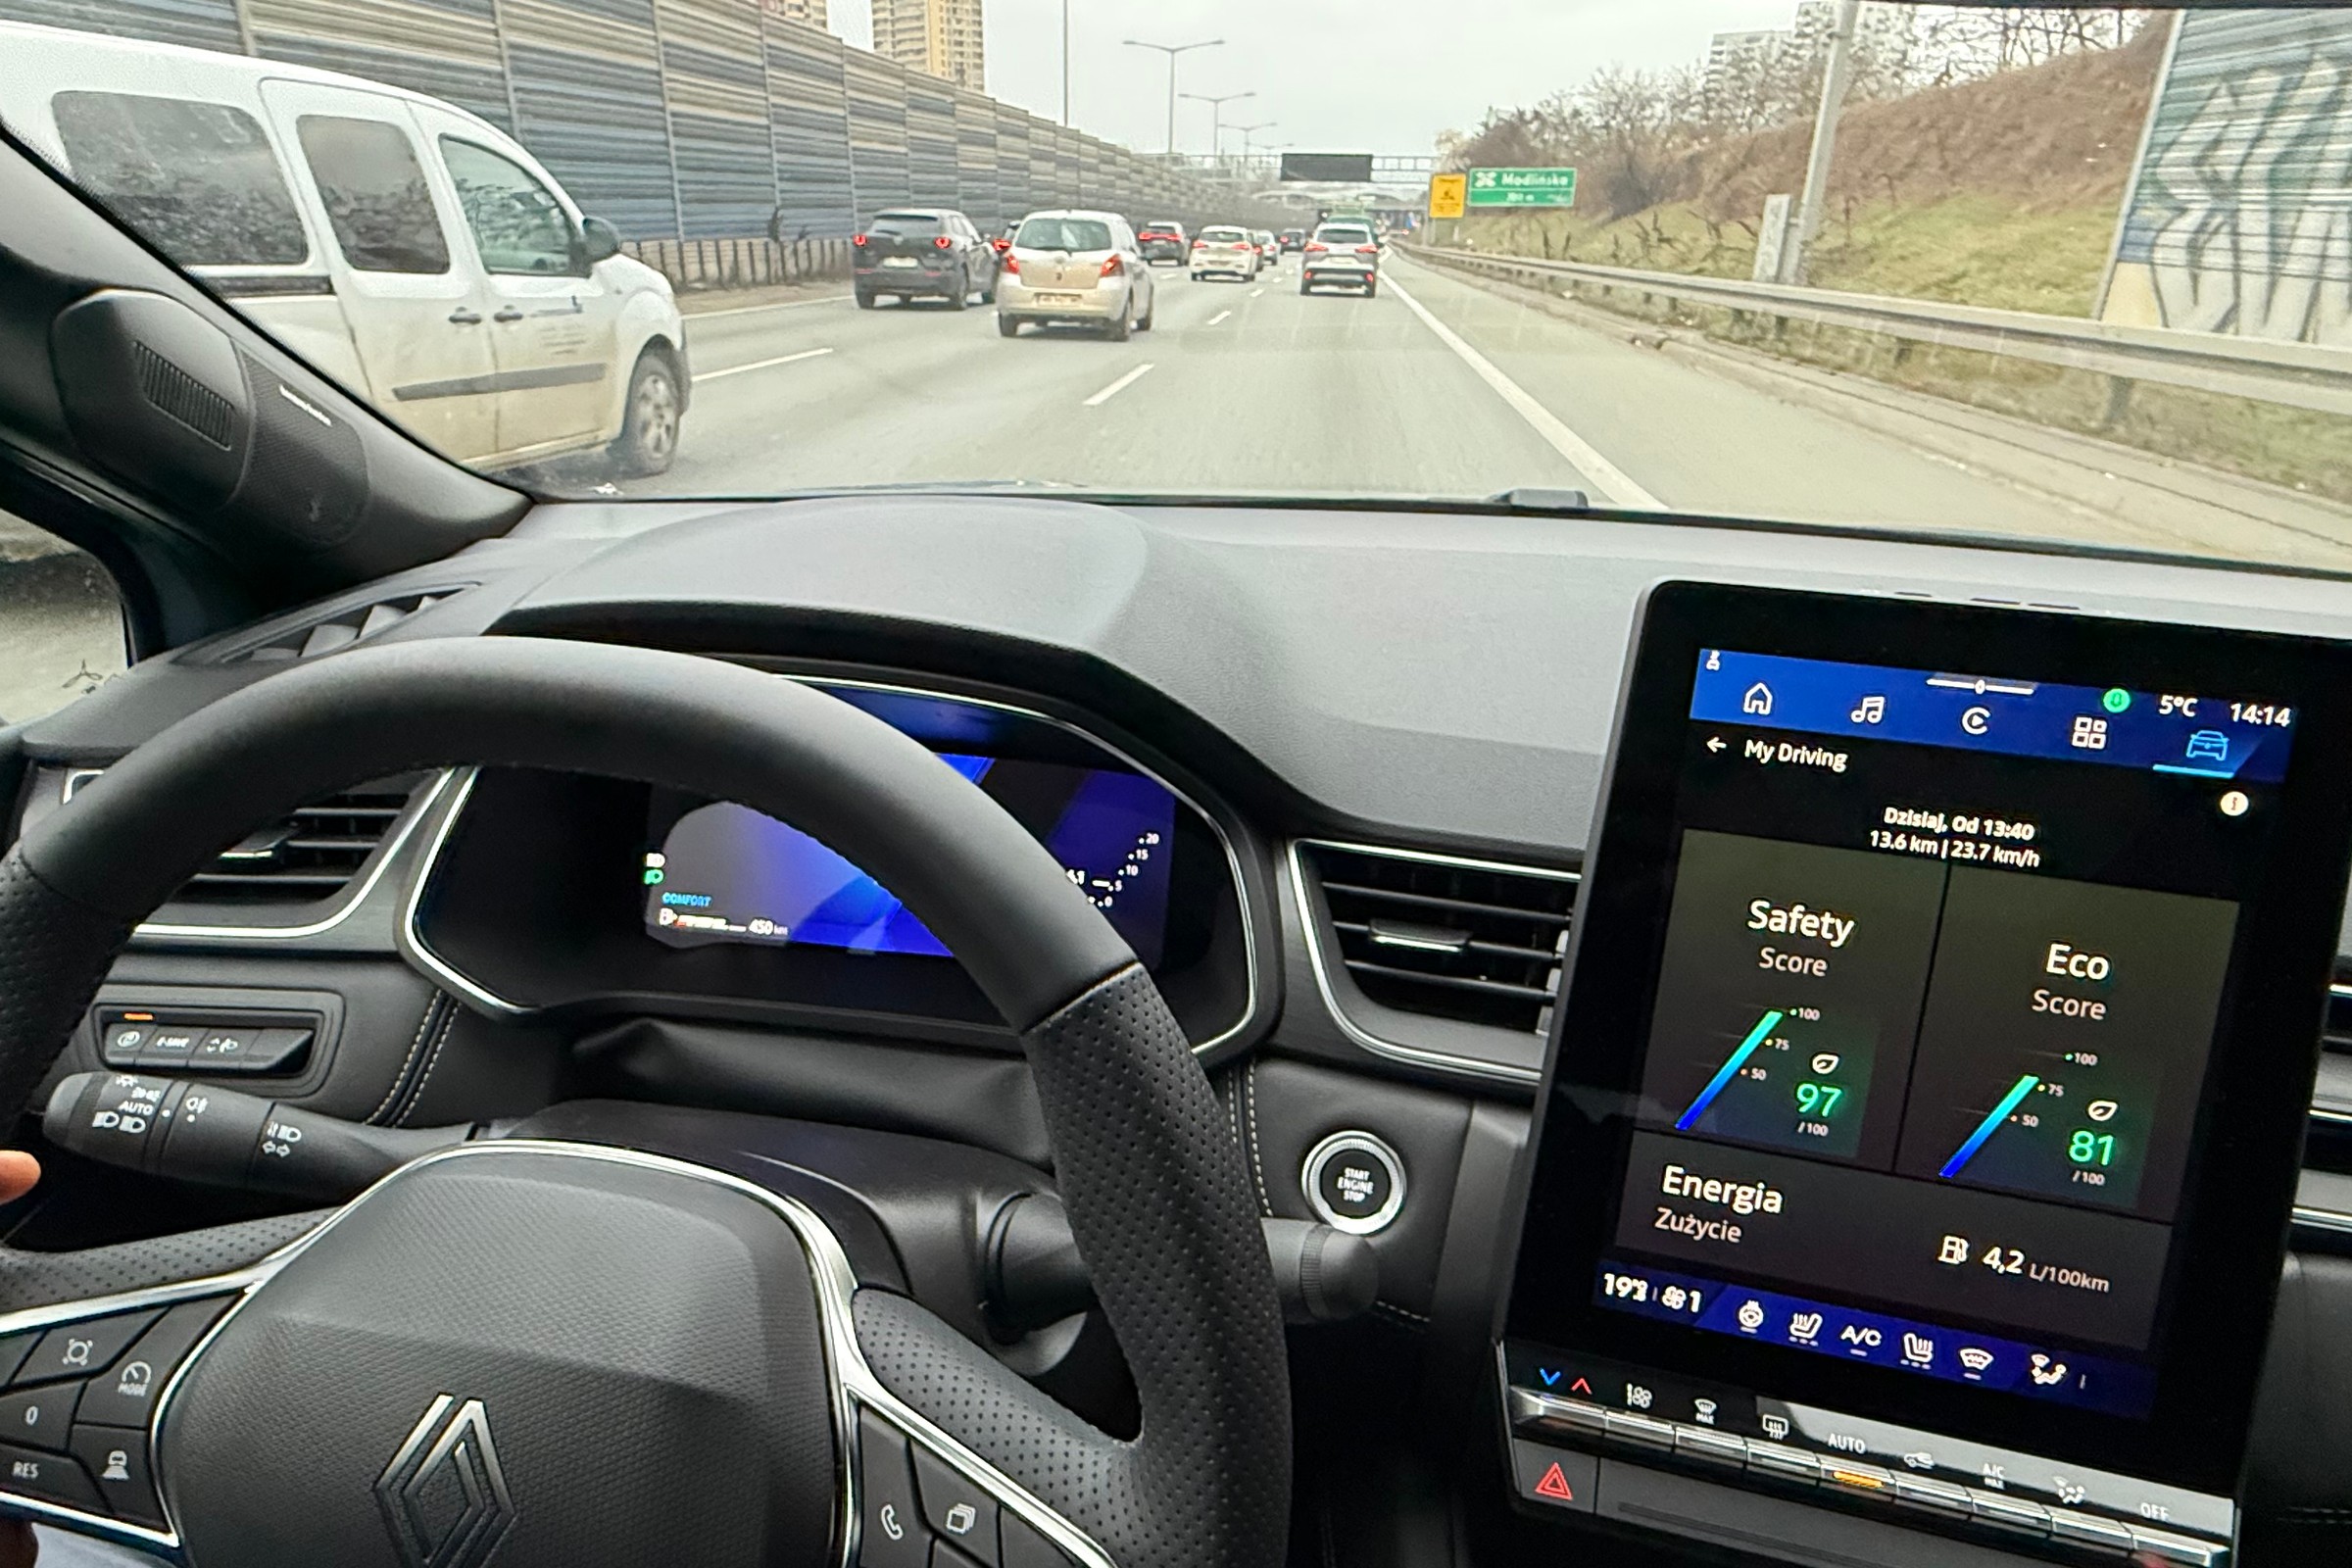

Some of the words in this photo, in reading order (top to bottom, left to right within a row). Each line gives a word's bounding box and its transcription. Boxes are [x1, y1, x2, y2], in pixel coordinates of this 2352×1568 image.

[2158, 695, 2198, 717] 5°C
[2230, 703, 2290, 727] 14:14
[1744, 739, 1775, 763] My
[1778, 743, 1847, 773] Driving
[1952, 816, 1980, 834] Od
[1984, 819, 2034, 841] 13:40
[1146, 832, 1159, 845] 20
[1136, 849, 1149, 860] 15
[1871, 830, 1906, 851] 13.6
[1909, 835, 1938, 856] km
[1951, 840, 1991, 861] 23.7
[1993, 846, 2040, 868] km/h
[1125, 864, 1139, 876] 10
[1114, 880, 1122, 892] 5
[662, 892, 711, 907] COMFORT
[1104, 896, 1113, 907] 0
[749, 918, 774, 936] 450
[1747, 900, 1854, 948] Safety
[1759, 947, 1828, 977] Score
[2046, 943, 2109, 980] Eco
[2032, 989, 2107, 1020] Score
[1798, 1007, 1821, 1021] 100
[1775, 1038, 1789, 1051] 75
[2075, 1053, 2098, 1066] 100
[1750, 1067, 1767, 1081] 50
[2048, 1083, 2064, 1097] 75
[118, 1100, 154, 1116] AUTO
[1796, 1083, 1842, 1117] 97
[2022, 1114, 2038, 1128] 50
[2069, 1130, 2114, 1166] 81
[1344, 1167, 1370, 1181] START
[1337, 1176, 1374, 1195] ENGINE
[1662, 1165, 1784, 1215] Energia
[1343, 1190, 1366, 1202] STOP
[1654, 1206, 1742, 1244] Zużycie
[1982, 1246, 2026, 1275] 4,2
[2029, 1262, 2110, 1294] L/100km
[1690, 1290, 1701, 1313] 1
[1840, 1325, 1882, 1347] A/C
[117, 1382, 148, 1396] MODE
[1828, 1433, 1866, 1454] AUTO
[12, 1461, 39, 1479] RES
[2140, 1502, 2170, 1519] OFF
